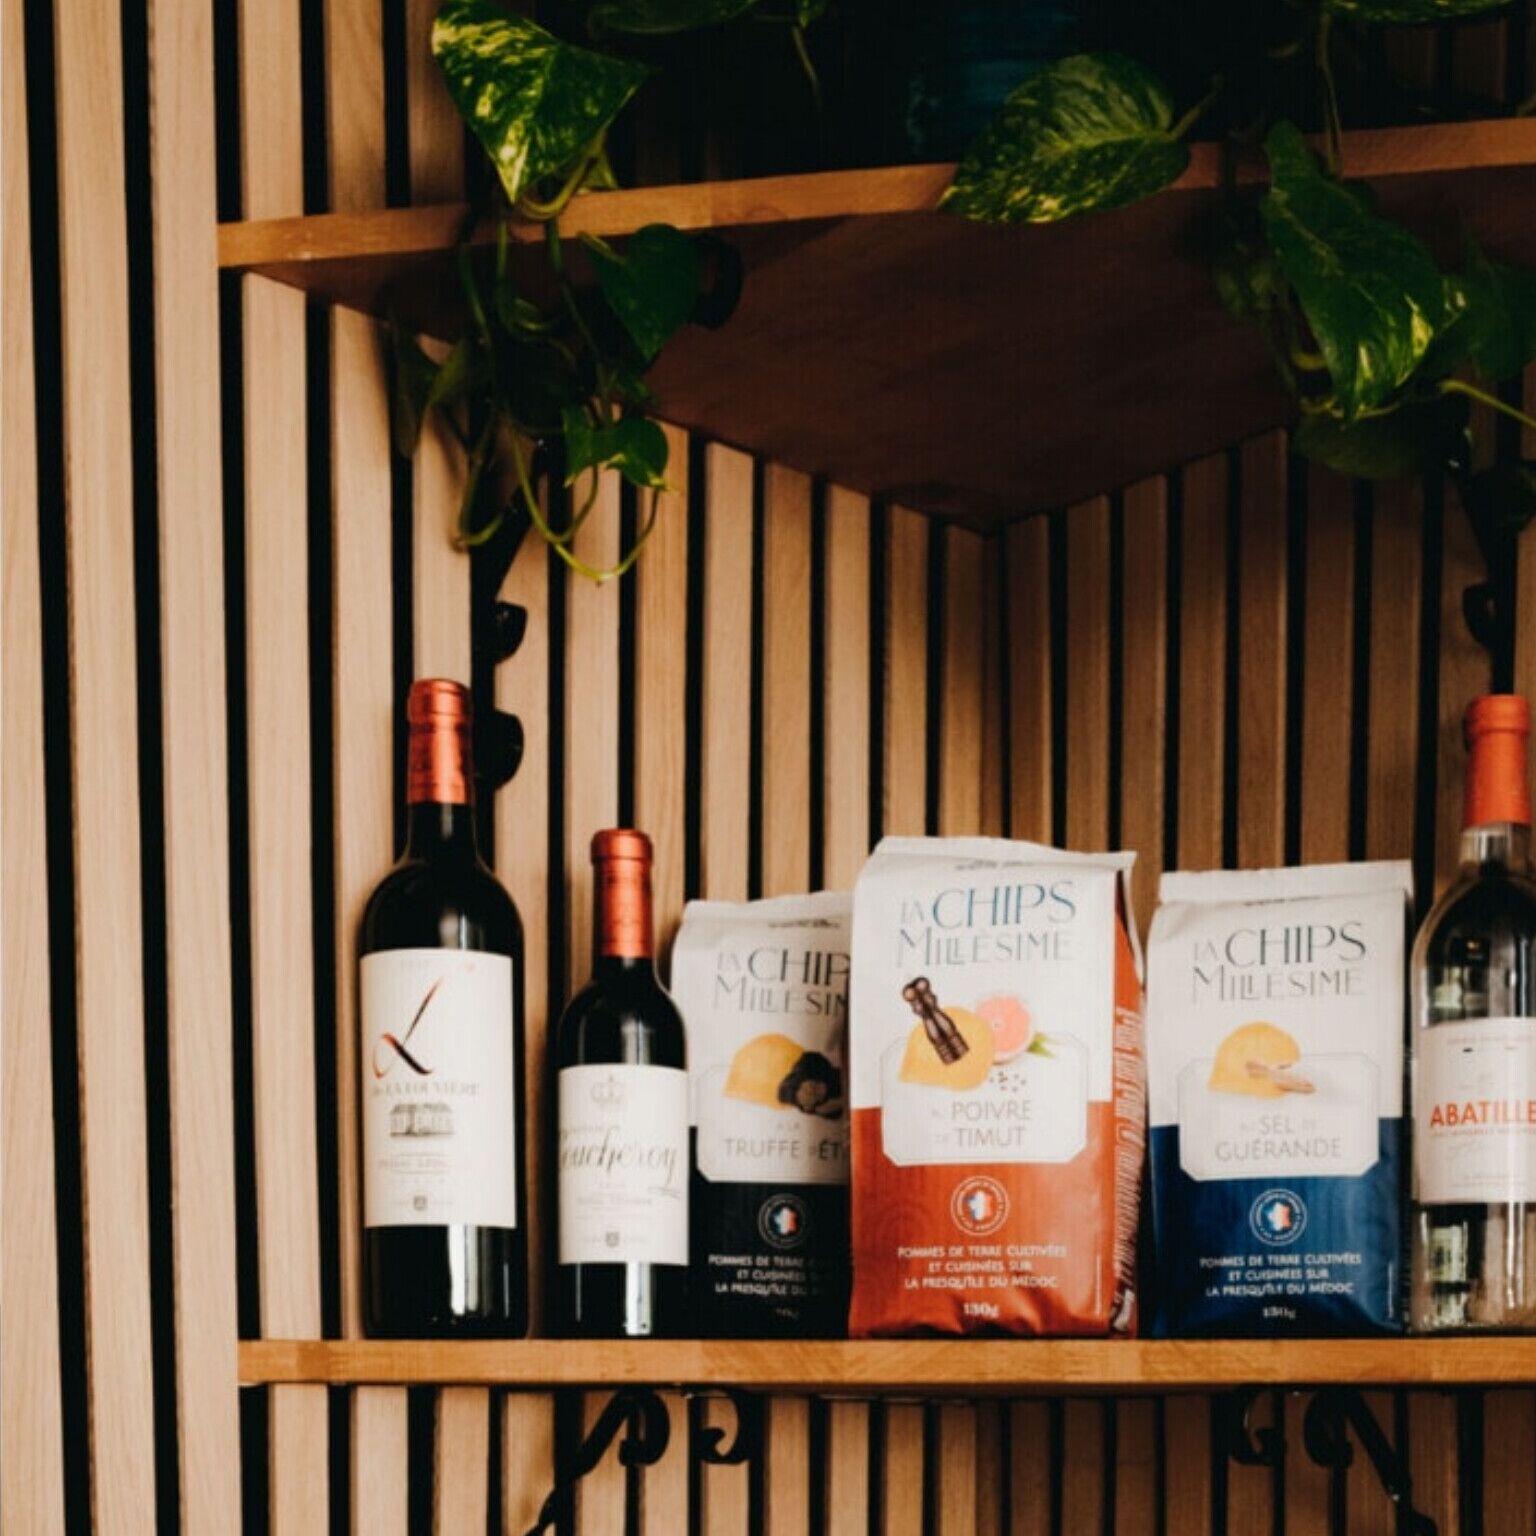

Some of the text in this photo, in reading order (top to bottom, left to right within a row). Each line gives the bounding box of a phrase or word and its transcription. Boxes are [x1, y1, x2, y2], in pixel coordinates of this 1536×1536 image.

[932, 880, 1077, 930] CHIPS
[1224, 920, 1367, 967] CHIPS
[951, 1099, 1033, 1121] POIVRE
[1259, 1114, 1296, 1135] SEL
[954, 1125, 1027, 1148] TIMUT
[724, 1137, 801, 1159] TRUFFE
[898, 1247, 945, 1258] POMMES
[954, 1246, 964, 1257] DE
[969, 1245, 1002, 1257] TERRE
[708, 1254, 753, 1266] POMMES
[756, 1254, 770, 1266] DE
[928, 1261, 941, 1272] ET
[1009, 1260, 1032, 1271] SUR
[1199, 1257, 1244, 1268] POMMES
[1249, 1256, 1263, 1267] DE
[1267, 1255, 1301, 1266] TERRE
[736, 1268, 749, 1280] ET
[1228, 1272, 1242, 1282] ET
[1306, 1268, 1329, 1280] SUR
[714, 1281, 729, 1293] LA
[905, 1278, 919, 1289] LA
[989, 1276, 1008, 1288] DU
[1206, 1287, 1220, 1297] LA
[1287, 1284, 1305, 1295] DU
